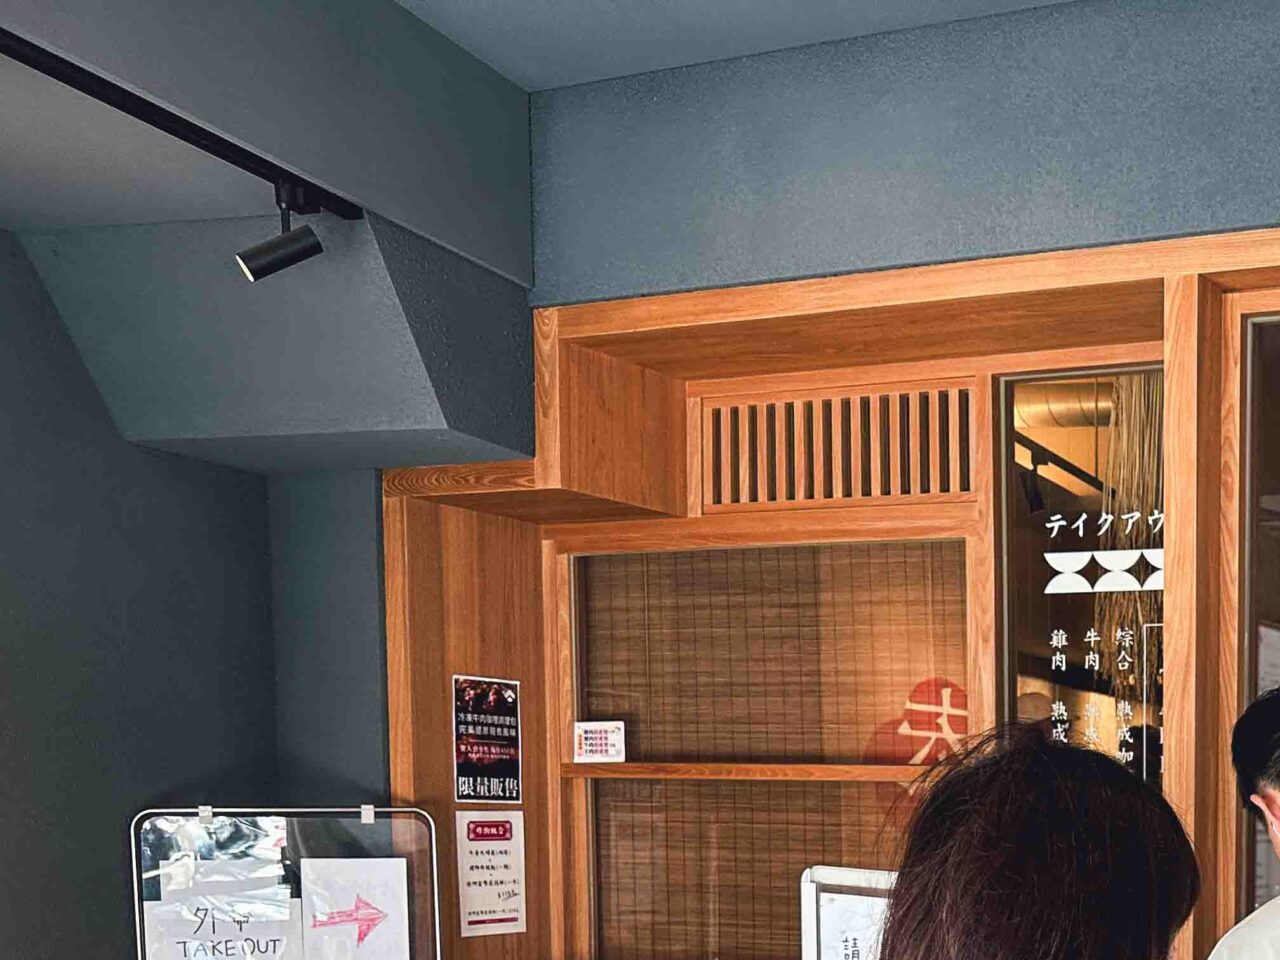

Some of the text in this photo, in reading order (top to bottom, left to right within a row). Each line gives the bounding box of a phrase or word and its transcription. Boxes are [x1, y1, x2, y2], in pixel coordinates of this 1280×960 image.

[1050, 629, 1068, 671] 雞肉
[1084, 628, 1101, 670] 牛肉
[1115, 628, 1134, 670] 綜合
[458, 776, 518, 798] 限量販售
[176, 937, 281, 958] TAKE OUT
